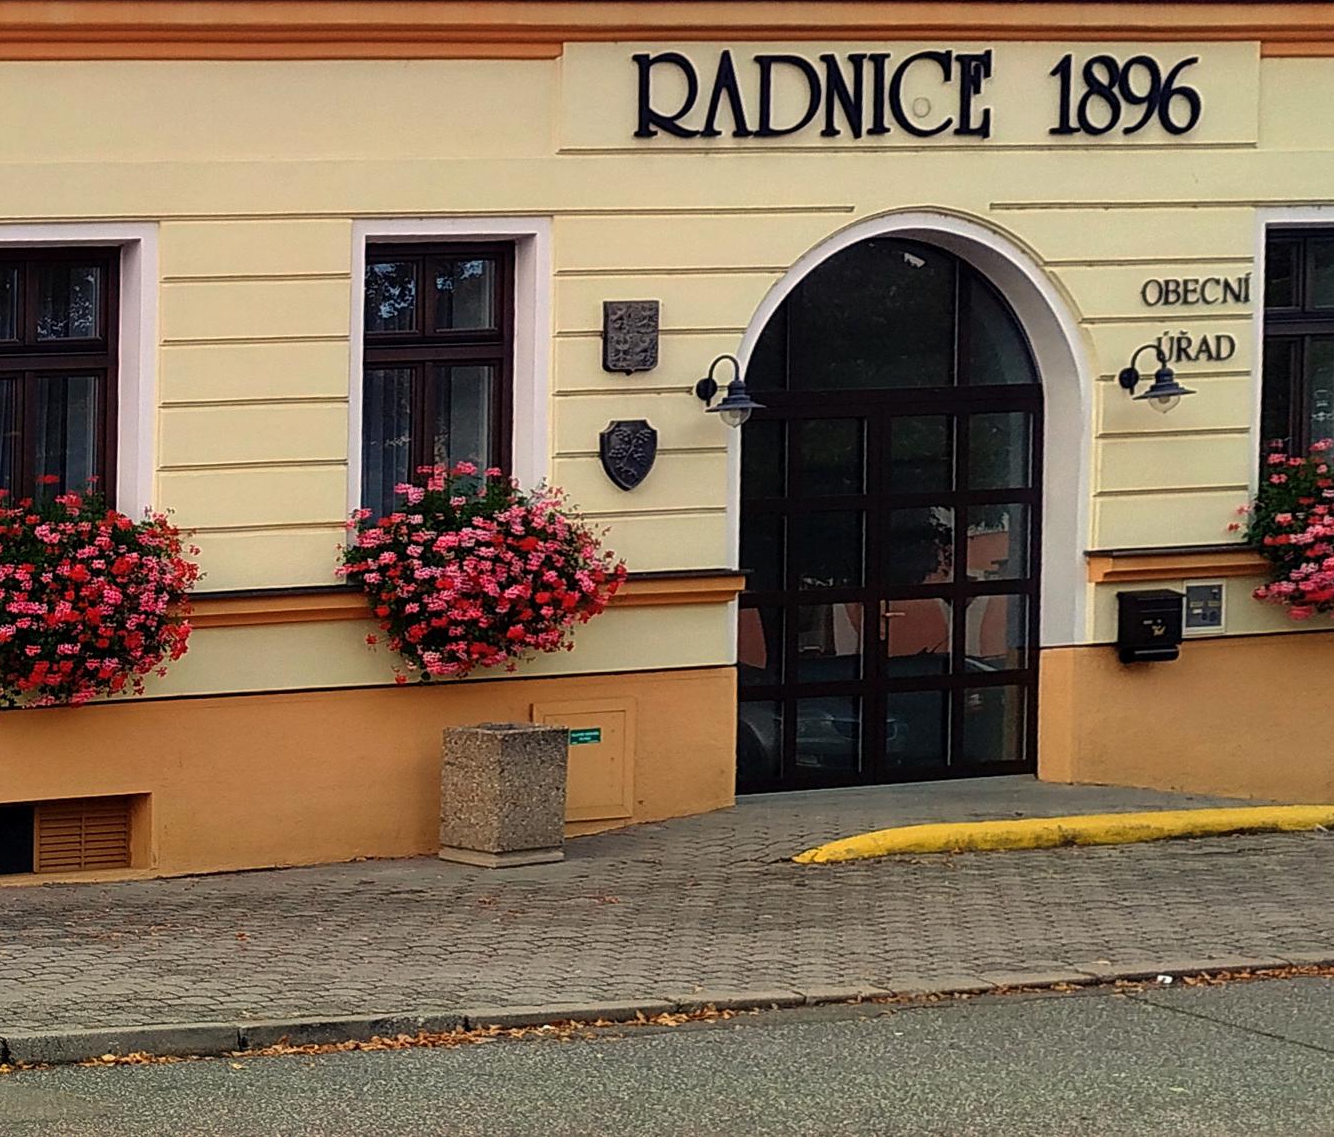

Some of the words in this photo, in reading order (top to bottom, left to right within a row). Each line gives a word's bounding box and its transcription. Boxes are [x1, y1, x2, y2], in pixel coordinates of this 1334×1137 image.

[632, 48, 993, 140] RADNICE
[1048, 53, 1203, 137] 1896
[1140, 271, 1253, 308] OBECNÍ
[1156, 330, 1237, 364] ÚŘAD
